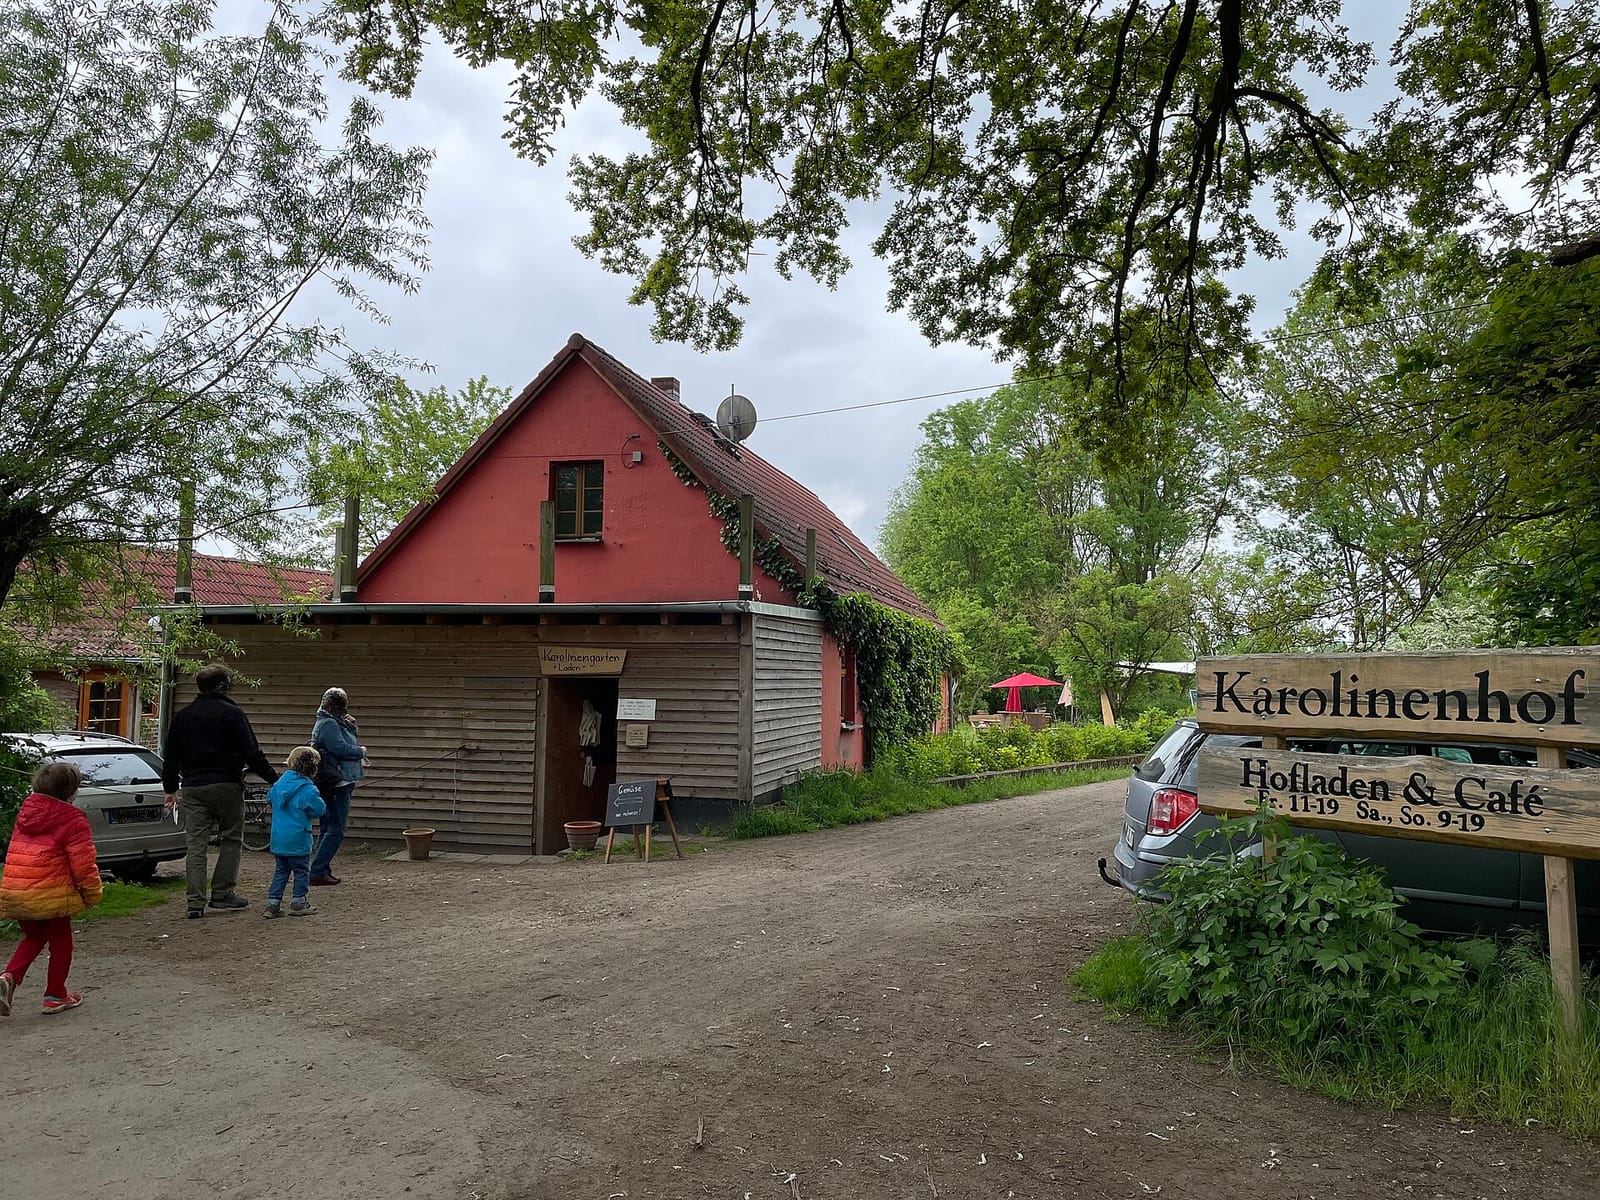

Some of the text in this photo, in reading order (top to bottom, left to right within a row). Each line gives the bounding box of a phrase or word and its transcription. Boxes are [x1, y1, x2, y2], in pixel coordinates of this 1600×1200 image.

[543, 648, 620, 667] Karolinengarten
[558, 663, 581, 672] Laden
[1213, 669, 1586, 725] Karolinenhof
[1239, 757, 1544, 817] Hofladen & Café
[1288, 794, 1339, 816] 11-19
[1356, 800, 1393, 825] Sa.,
[1399, 805, 1432, 827] So.
[1437, 810, 1486, 832] 9-19
